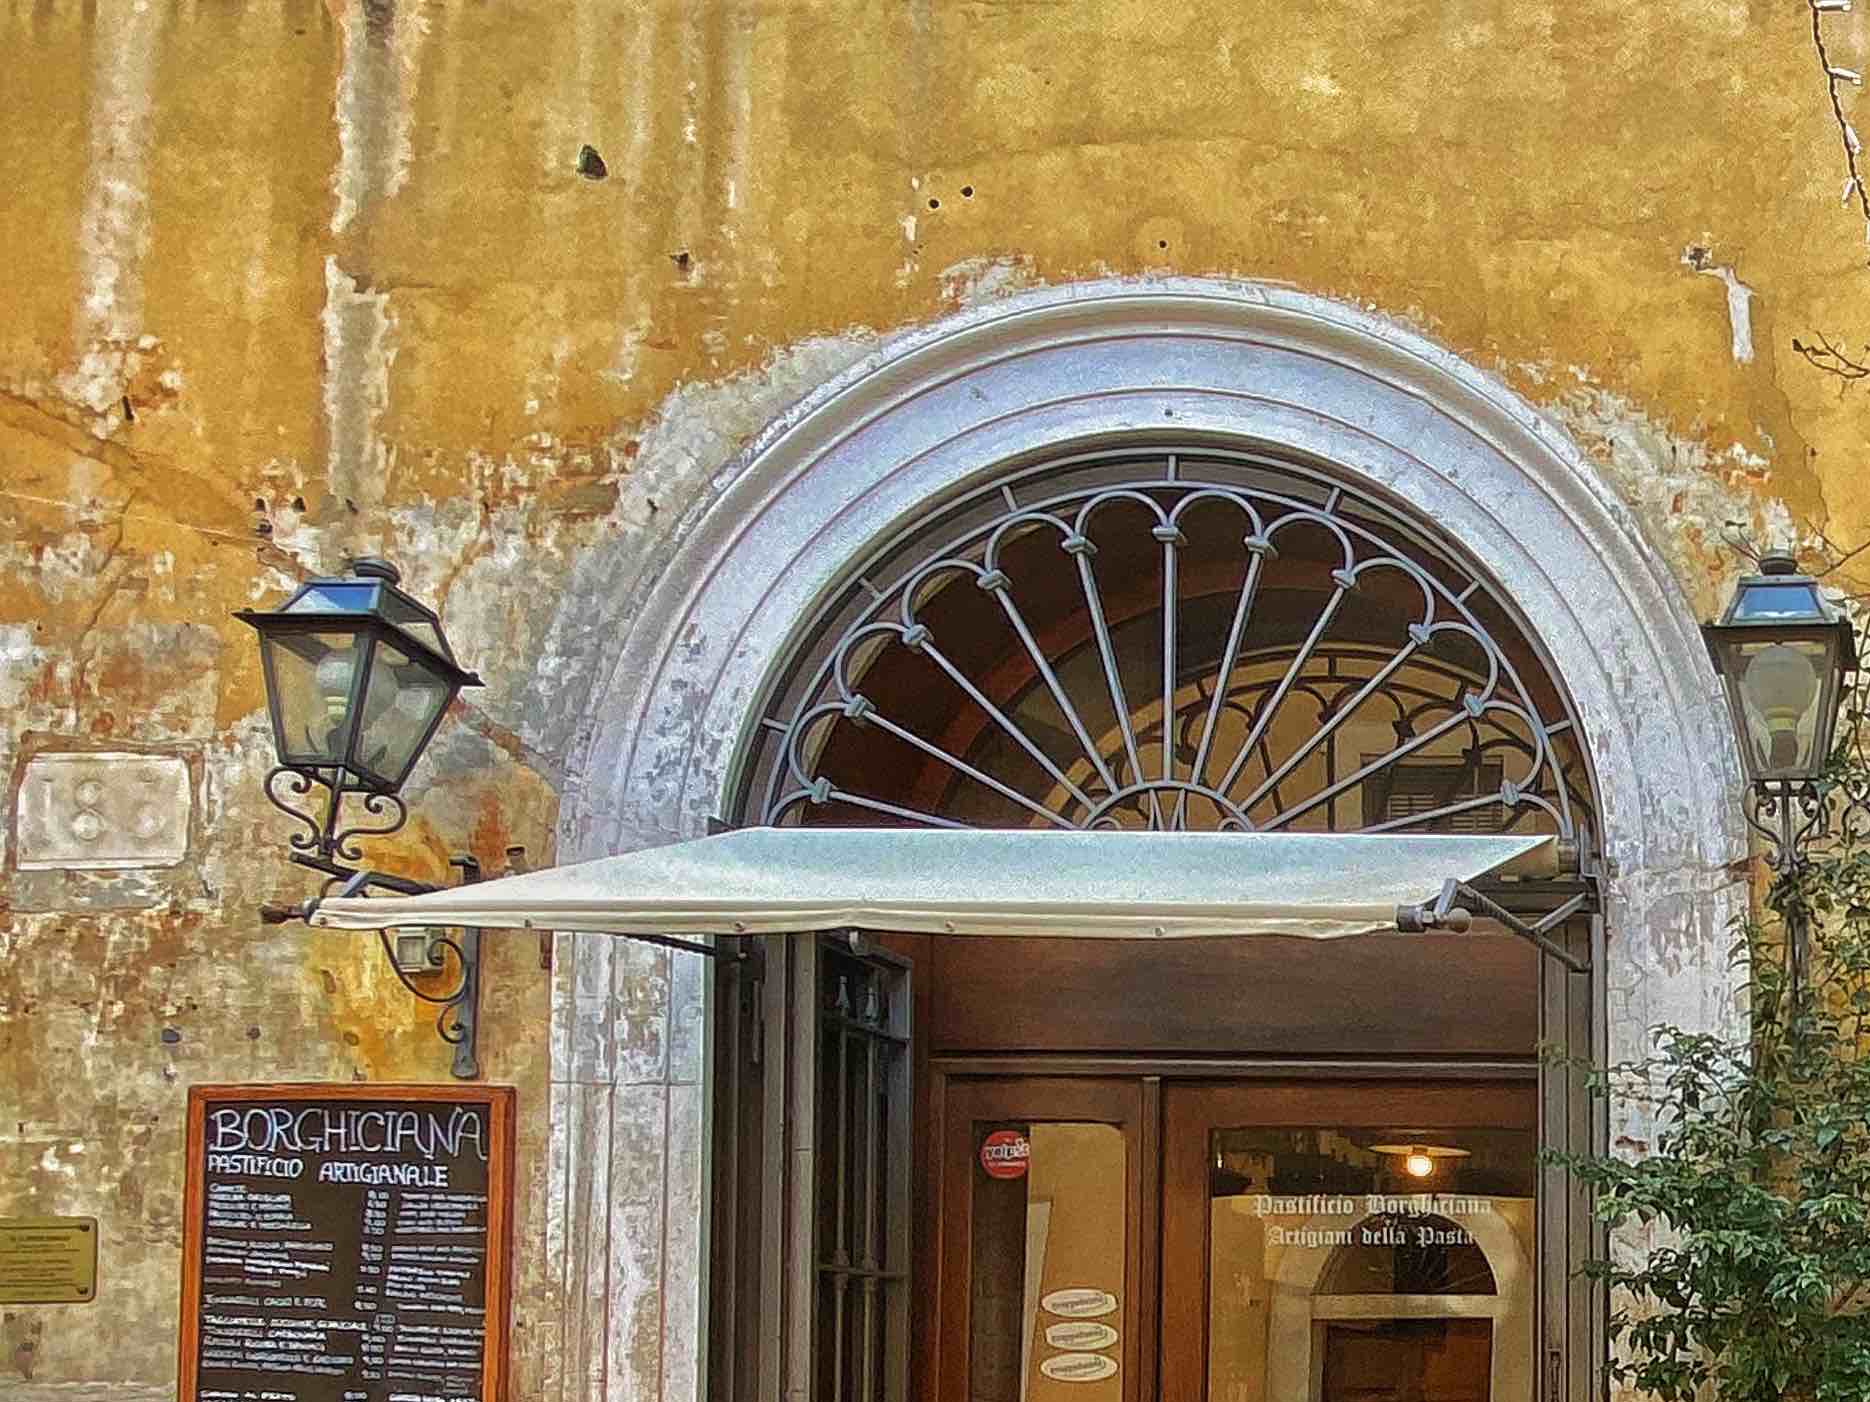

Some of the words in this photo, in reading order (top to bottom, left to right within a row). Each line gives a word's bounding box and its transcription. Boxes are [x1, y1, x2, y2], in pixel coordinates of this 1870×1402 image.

[208, 1107, 488, 1160] BORGHICIANA
[208, 1154, 304, 1178] PASTIFICIO
[319, 1161, 449, 1187] ARTIGIANALE
[1255, 1193, 1354, 1217] Pastificio
[1366, 1193, 1492, 1218] Borghiciana
[1266, 1226, 1353, 1249] Artigiani
[1361, 1226, 1406, 1246] della
[1415, 1226, 1475, 1247] Pasta
